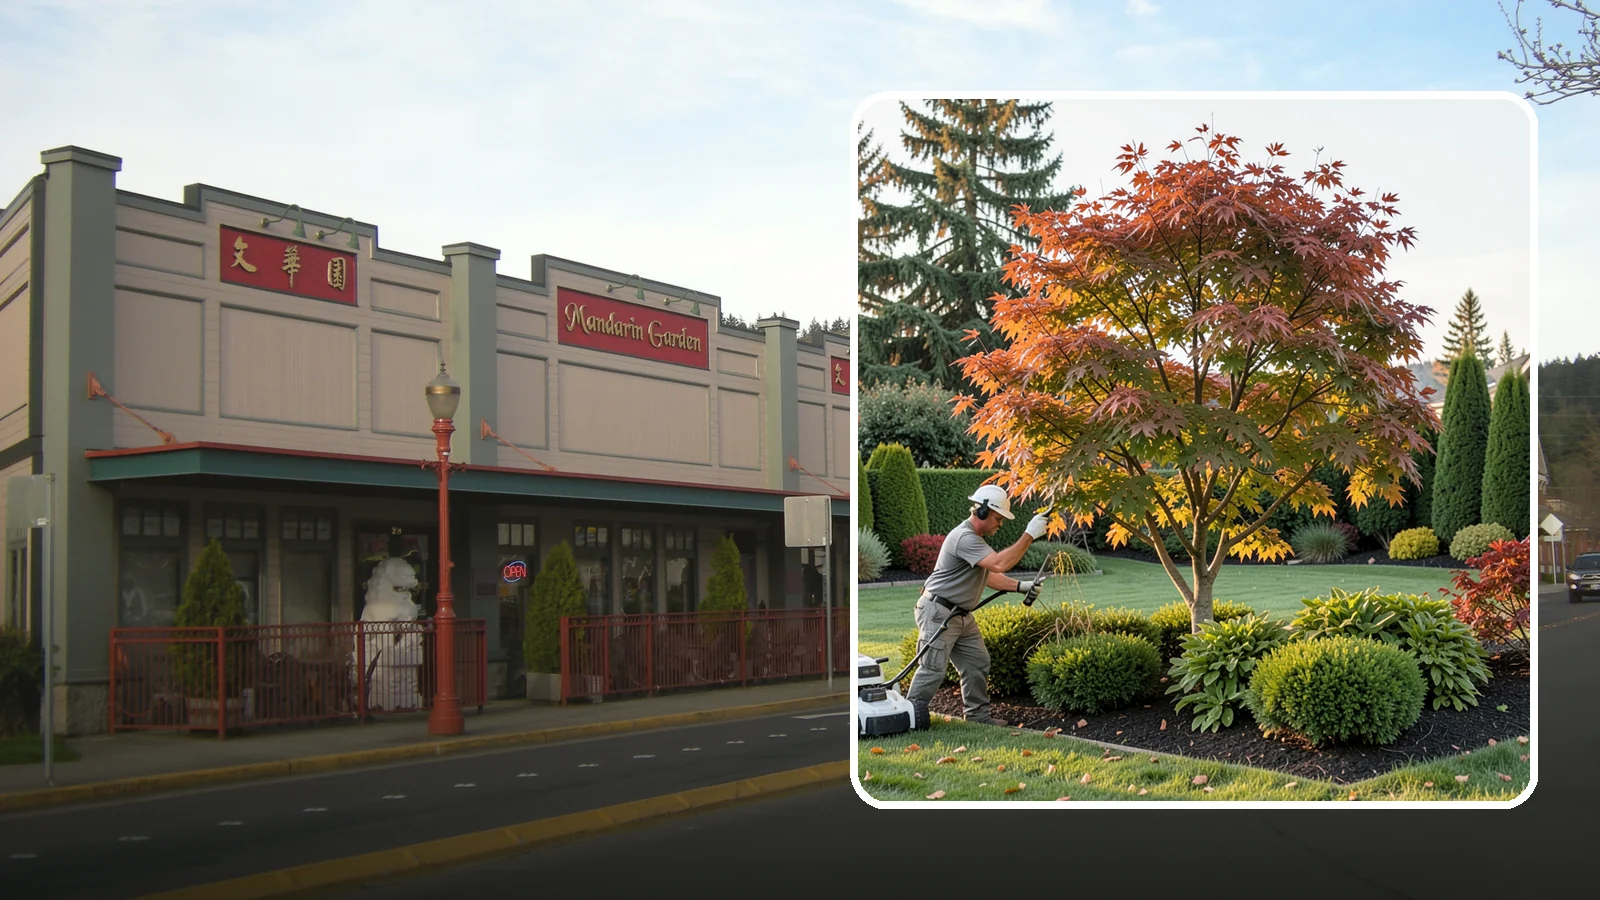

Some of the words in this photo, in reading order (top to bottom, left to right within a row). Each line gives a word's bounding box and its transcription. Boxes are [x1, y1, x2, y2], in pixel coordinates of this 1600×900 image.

[564, 302, 644, 340] Mandarin
[648, 320, 701, 352] Garden
[503, 565, 527, 578] OPEN
